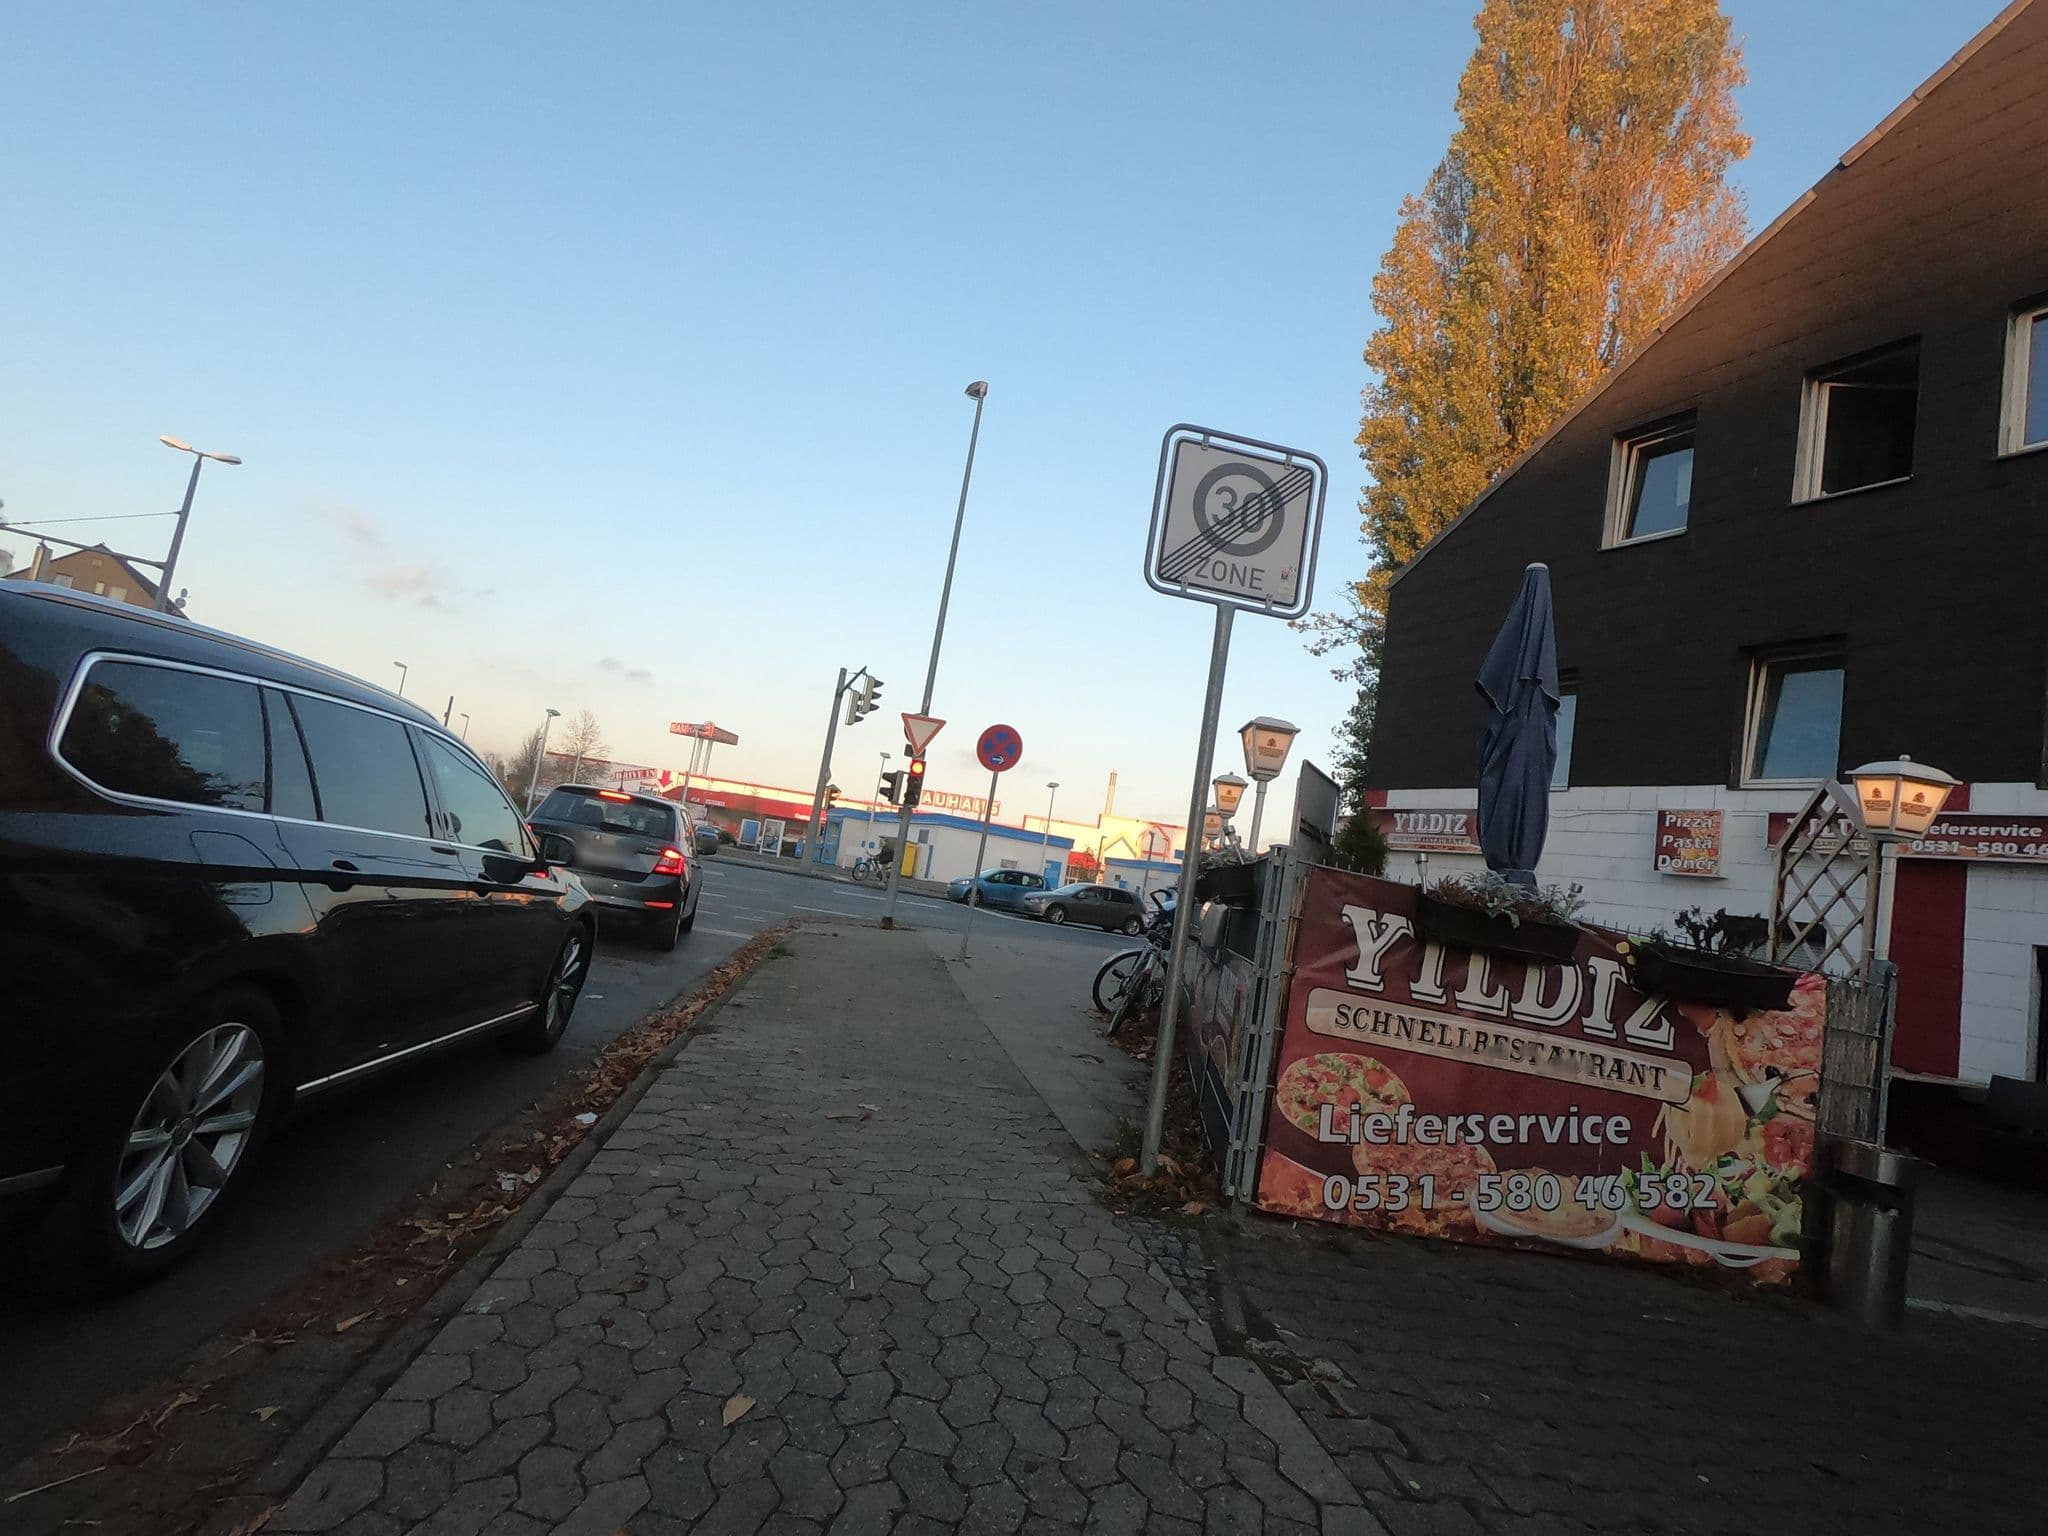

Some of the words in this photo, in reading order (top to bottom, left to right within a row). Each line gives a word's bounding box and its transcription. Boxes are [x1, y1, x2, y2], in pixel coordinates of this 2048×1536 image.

[1212, 486, 1264, 533] 30
[1195, 558, 1265, 591] ZONE
[922, 789, 1001, 816] AUHAUS
[1394, 813, 1468, 834] YILDIZ
[1665, 814, 1713, 828] Pizza
[1930, 822, 2042, 837] eferservice
[1662, 835, 1712, 848] Pasta
[1911, 840, 1959, 853] 0531
[1978, 842, 2018, 855] 580
[1318, 1102, 1631, 1145] Lieferservice
[1323, 1174, 1435, 1211] 0531
[1479, 1174, 1562, 1212] 580
[1575, 1174, 1625, 1211] 46
[1638, 1173, 1719, 1210] 582
